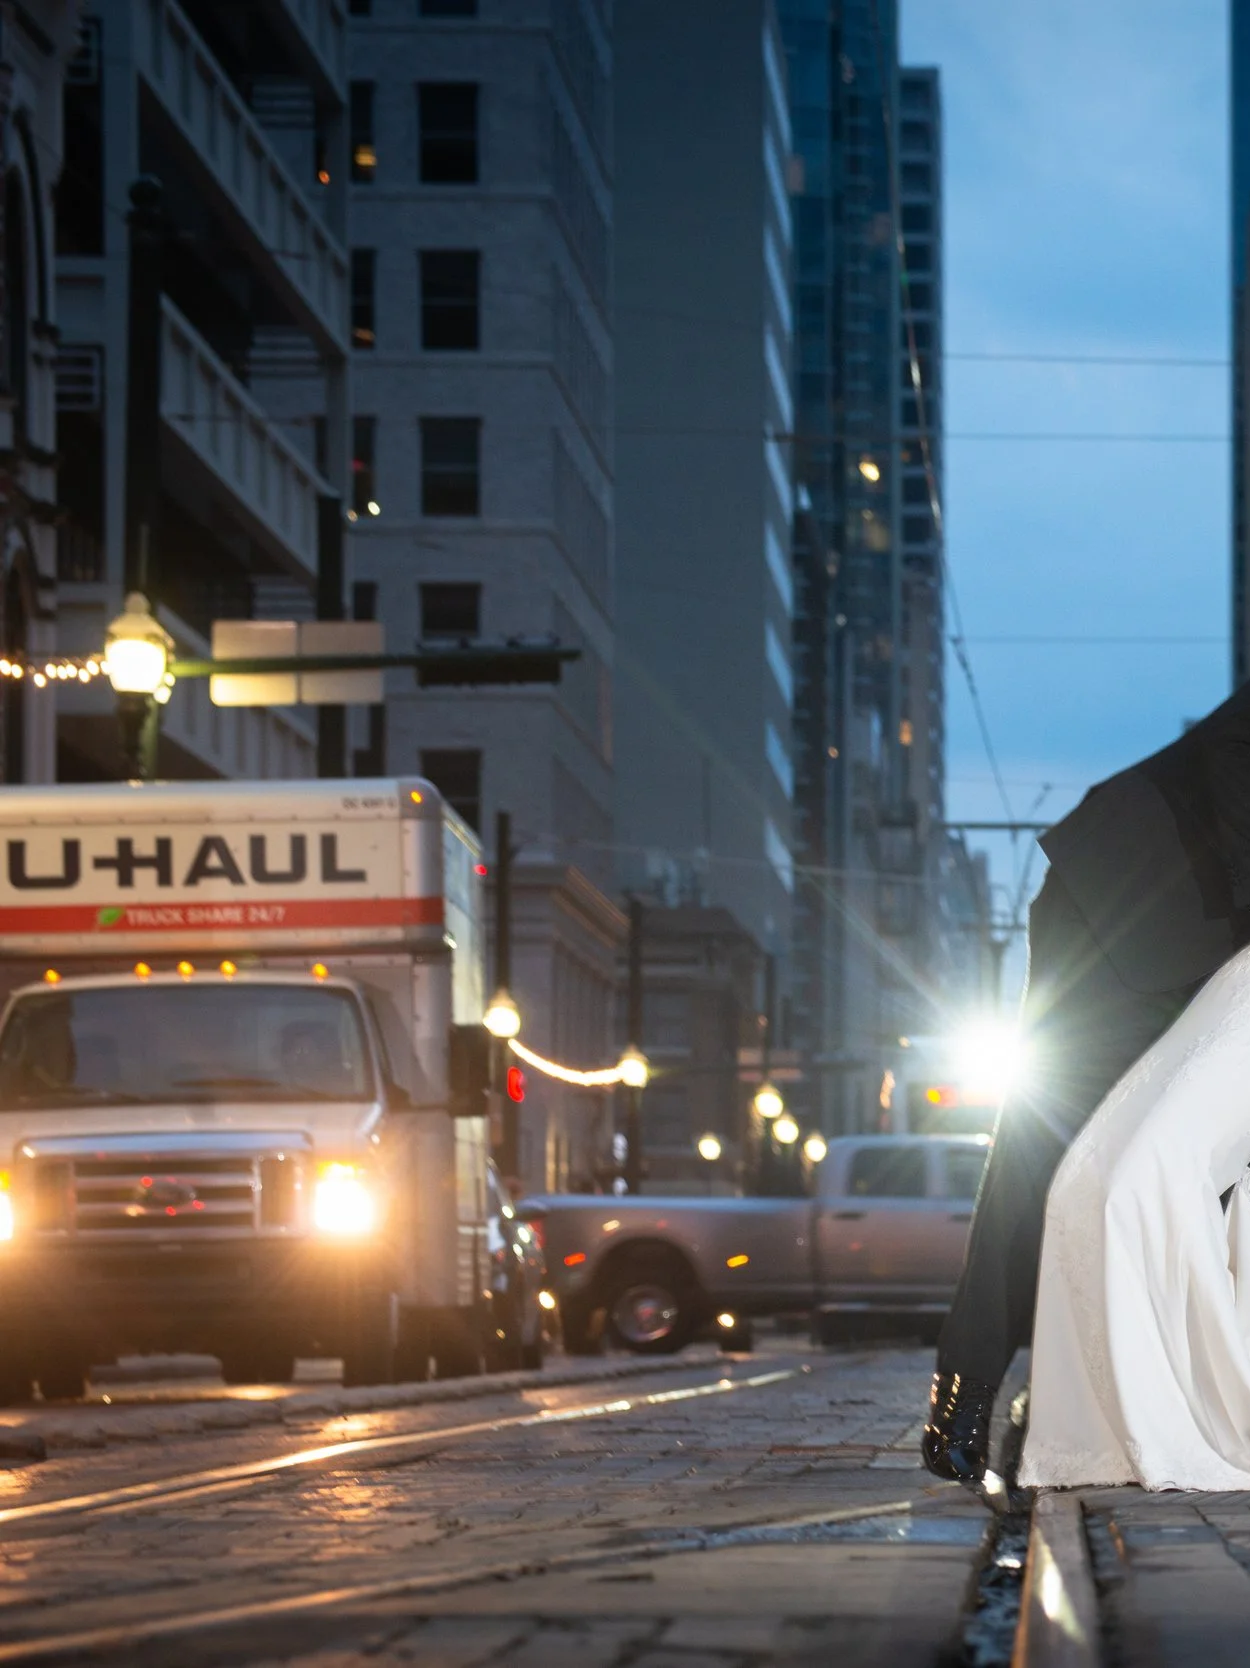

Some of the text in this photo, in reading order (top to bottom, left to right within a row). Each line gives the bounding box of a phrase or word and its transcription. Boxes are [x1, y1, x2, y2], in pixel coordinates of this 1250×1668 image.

[8, 833, 367, 889] U-HAUL
[126, 907, 185, 926] TRUCK
[187, 905, 243, 924] SHARE
